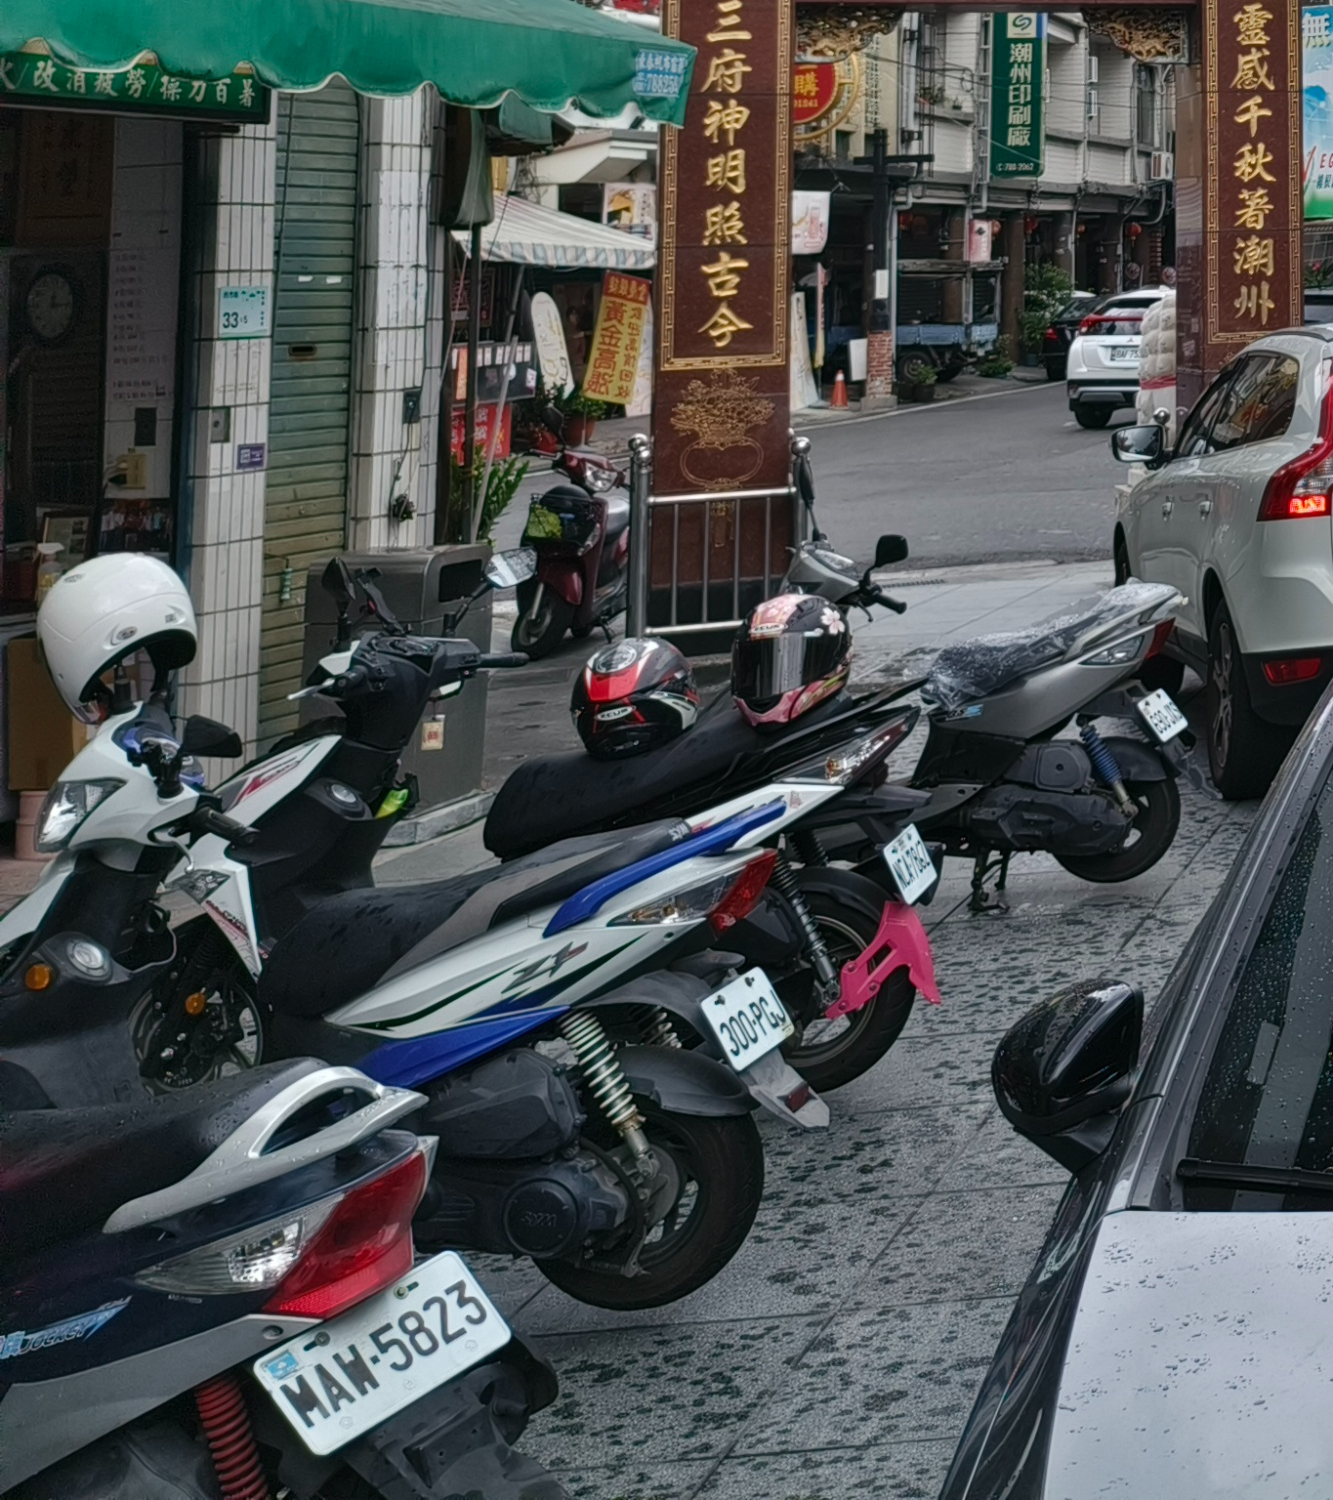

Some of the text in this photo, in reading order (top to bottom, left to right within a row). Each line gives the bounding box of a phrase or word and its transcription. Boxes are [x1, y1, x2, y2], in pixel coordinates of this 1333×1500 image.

[1007, 42, 1033, 148] 潮州印刷廠
